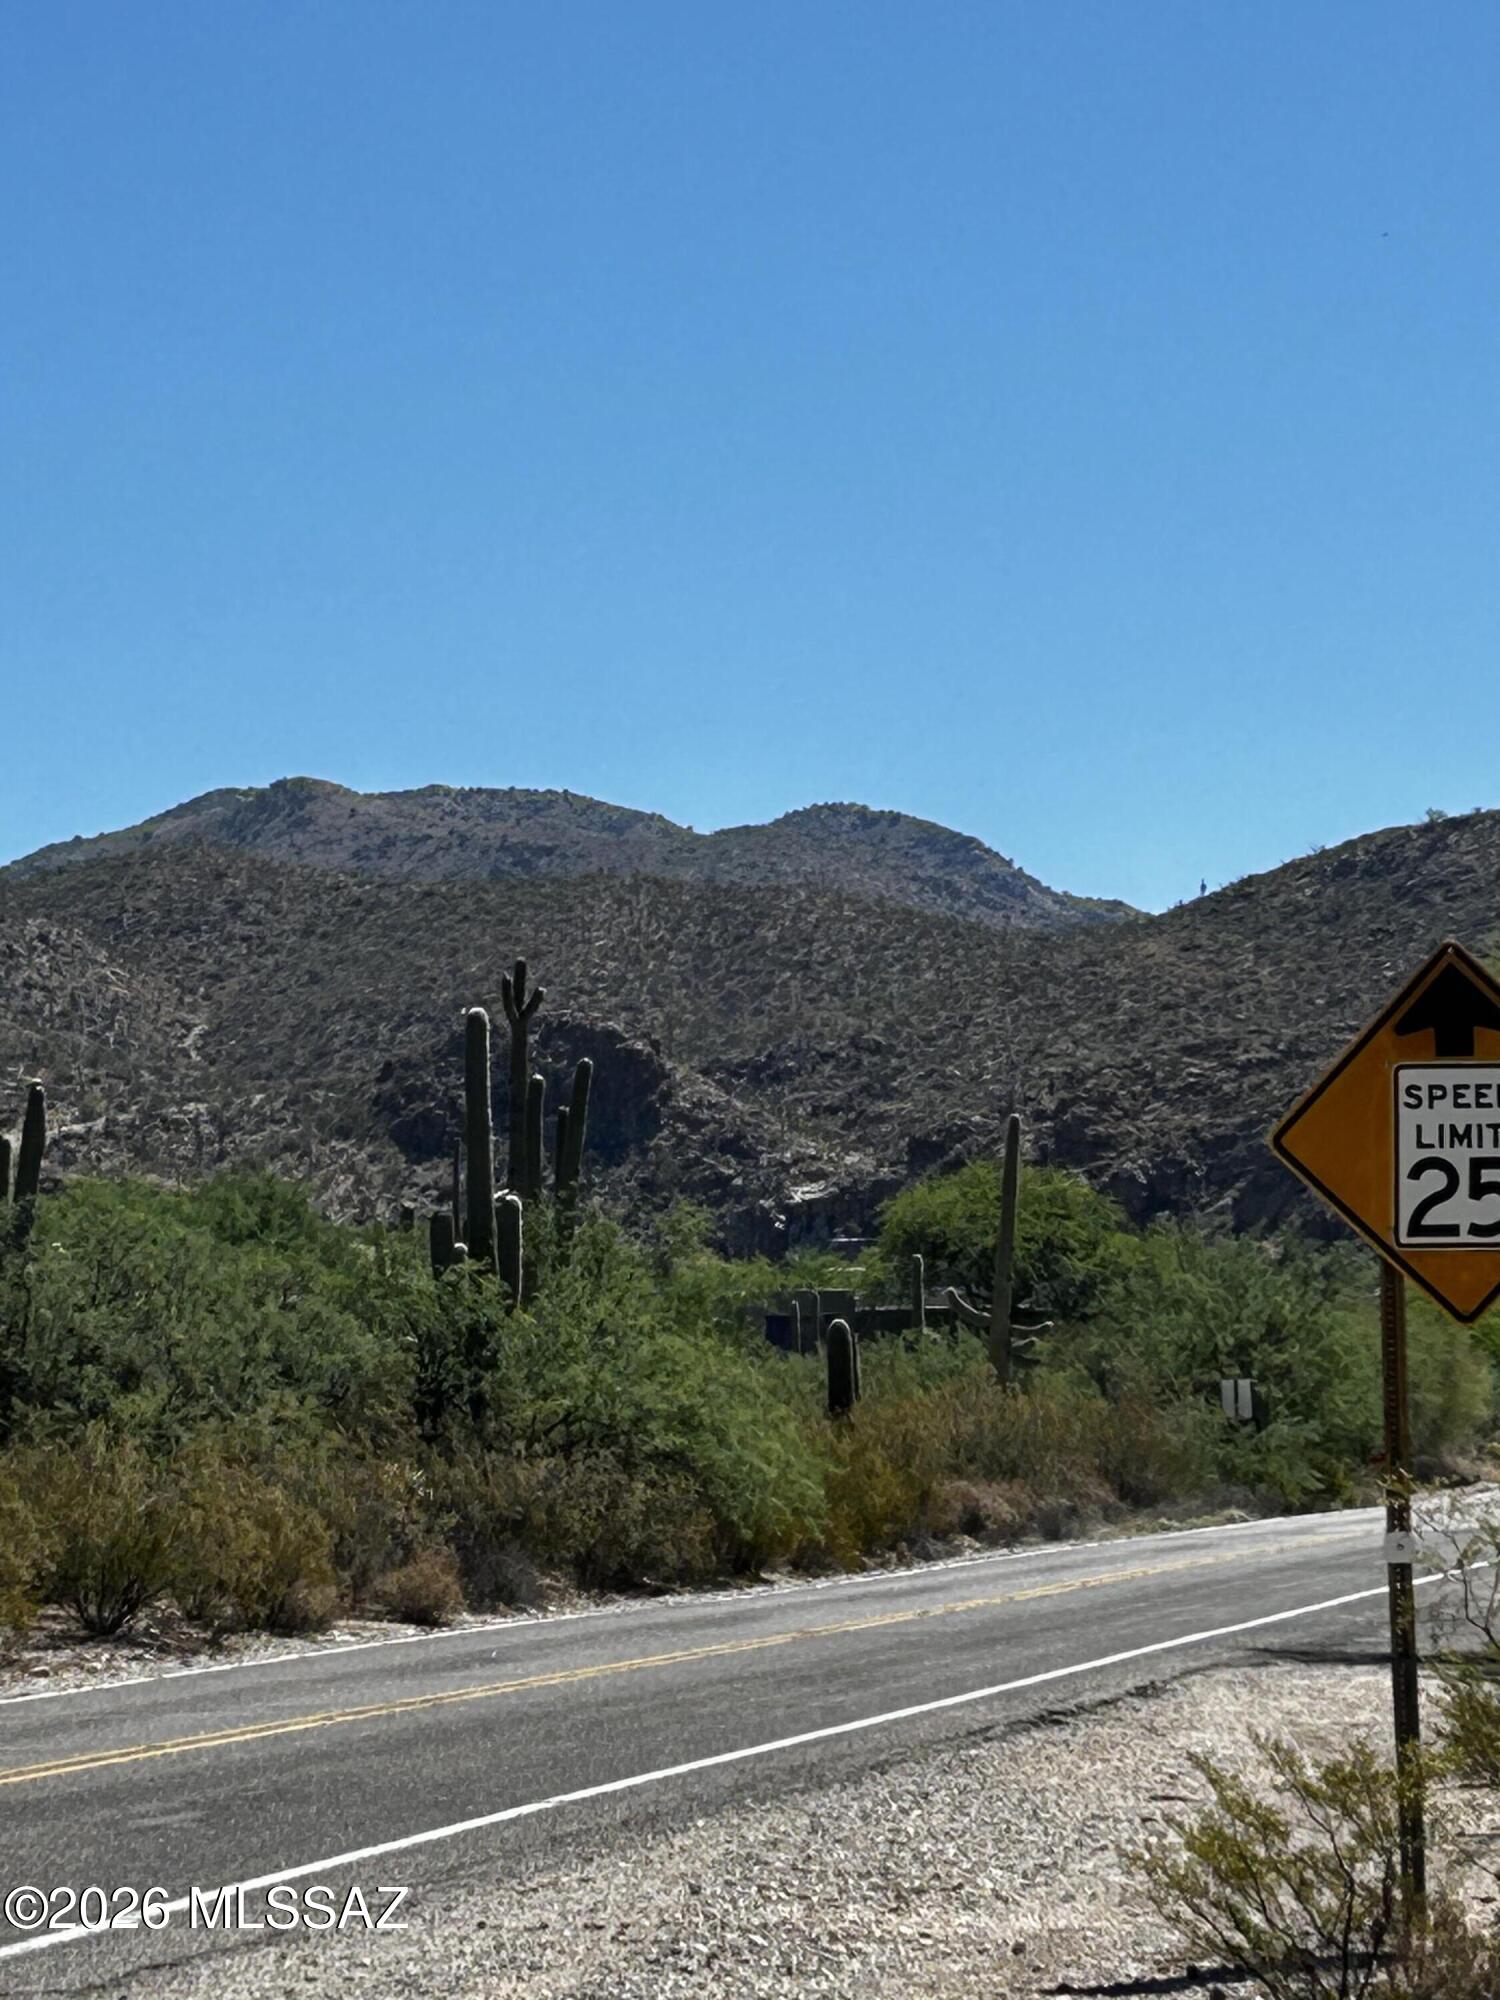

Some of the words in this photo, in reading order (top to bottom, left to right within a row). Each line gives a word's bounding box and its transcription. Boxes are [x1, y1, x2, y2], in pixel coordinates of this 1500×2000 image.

[1403, 1084, 1500, 1109] SPEE
[1416, 1123, 1500, 1149] LIMIT
[1406, 1156, 1500, 1238] 25
